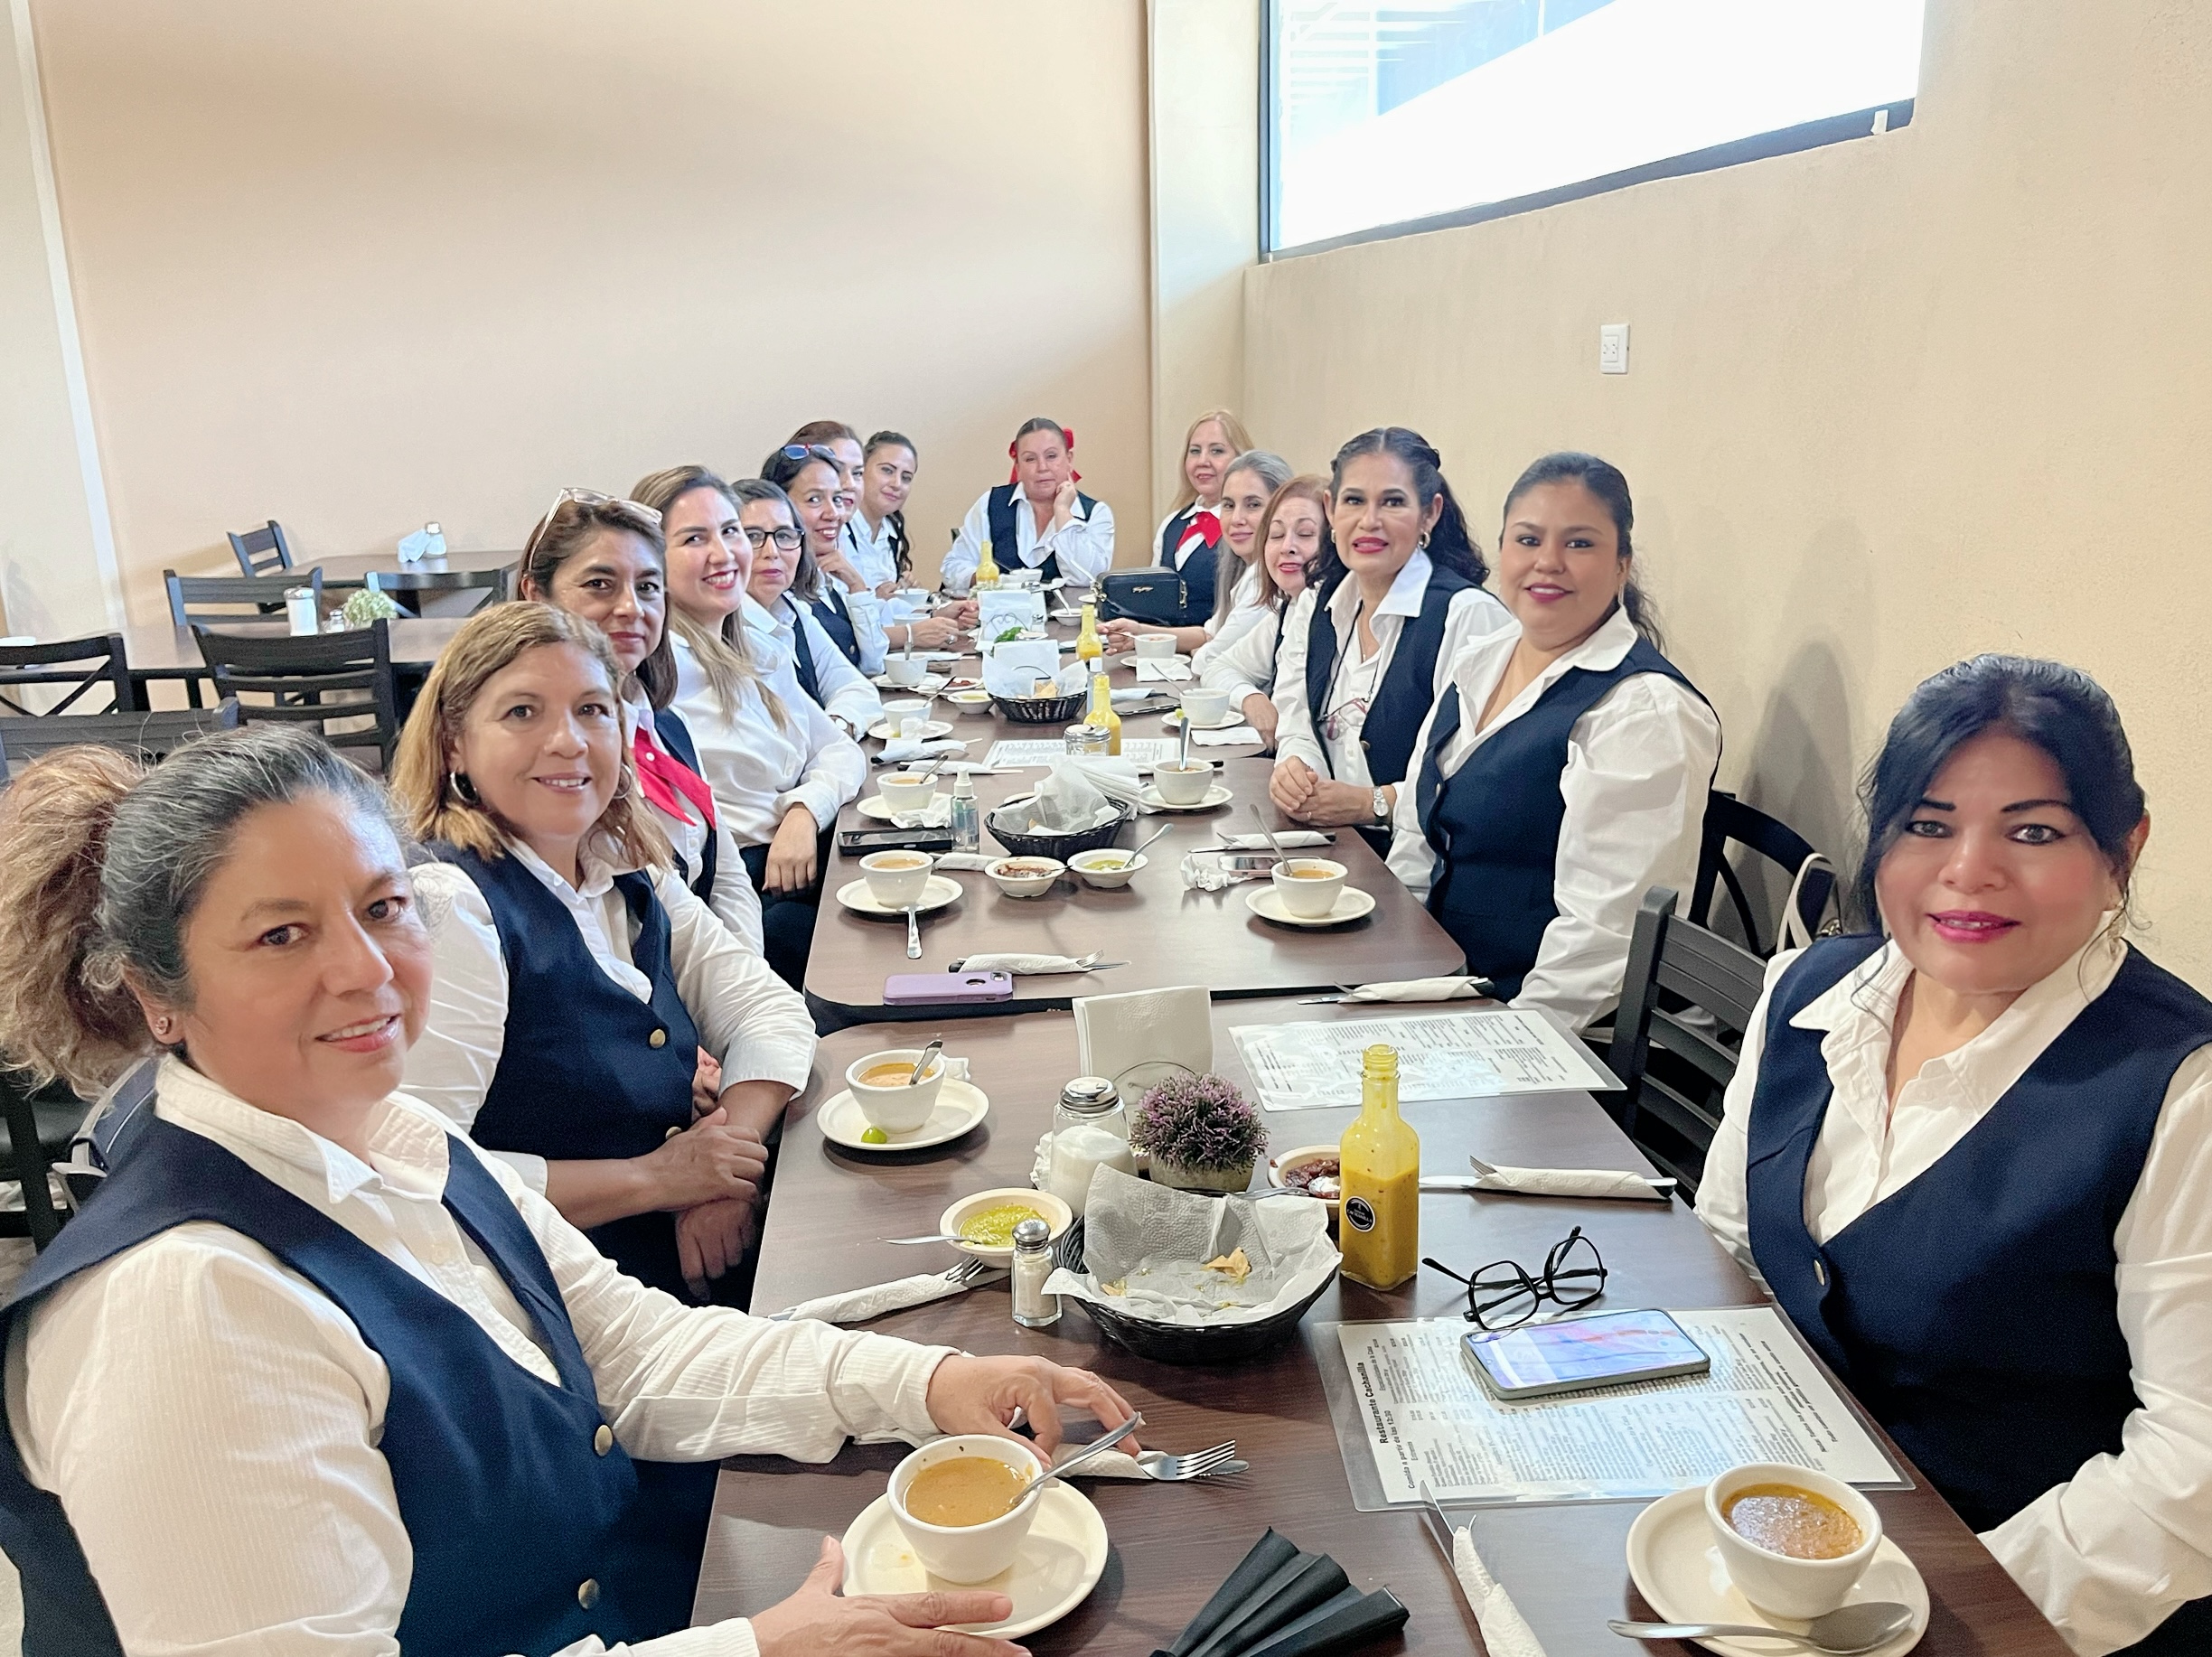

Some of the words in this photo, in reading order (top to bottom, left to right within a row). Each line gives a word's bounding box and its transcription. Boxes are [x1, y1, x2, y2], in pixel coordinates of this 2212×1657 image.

[1356, 1362, 1374, 1398] Cachanilla
[1369, 1399, 1389, 1444] Restaurante
[1384, 1410, 1394, 1425] 12:30
[1396, 1444, 1408, 1460] partir
[1403, 1467, 1415, 1489] Comida
